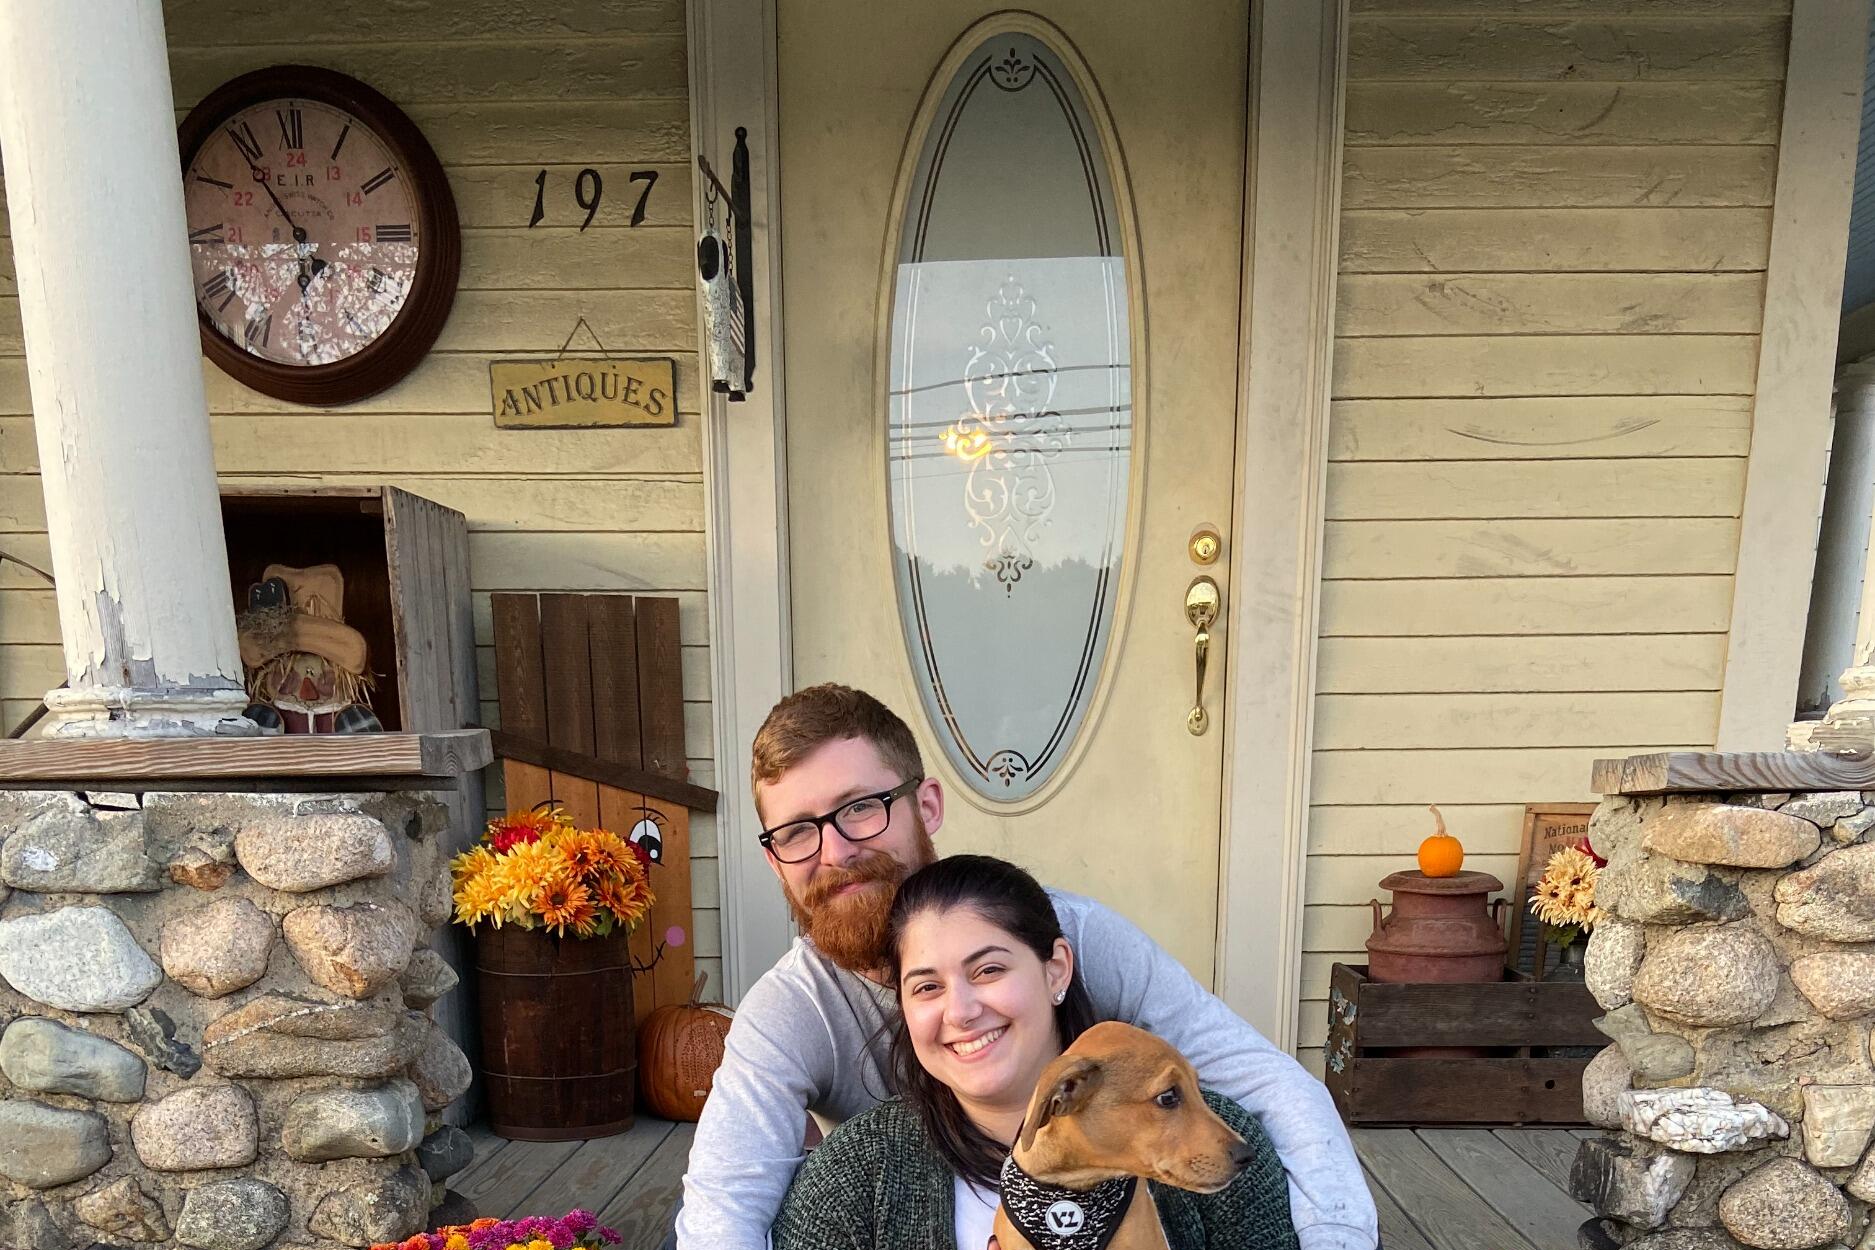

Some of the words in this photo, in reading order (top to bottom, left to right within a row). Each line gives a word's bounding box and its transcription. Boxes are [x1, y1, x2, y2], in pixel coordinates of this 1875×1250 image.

[286, 152, 307, 168] 24
[253, 166, 271, 182] 3
[326, 165, 341, 181] 13
[234, 191, 253, 207] 22
[346, 191, 362, 207] 14
[529, 168, 659, 232] 197
[228, 226, 242, 243] 21
[356, 226, 371, 243] 15
[500, 371, 667, 416] ANTIQUES
